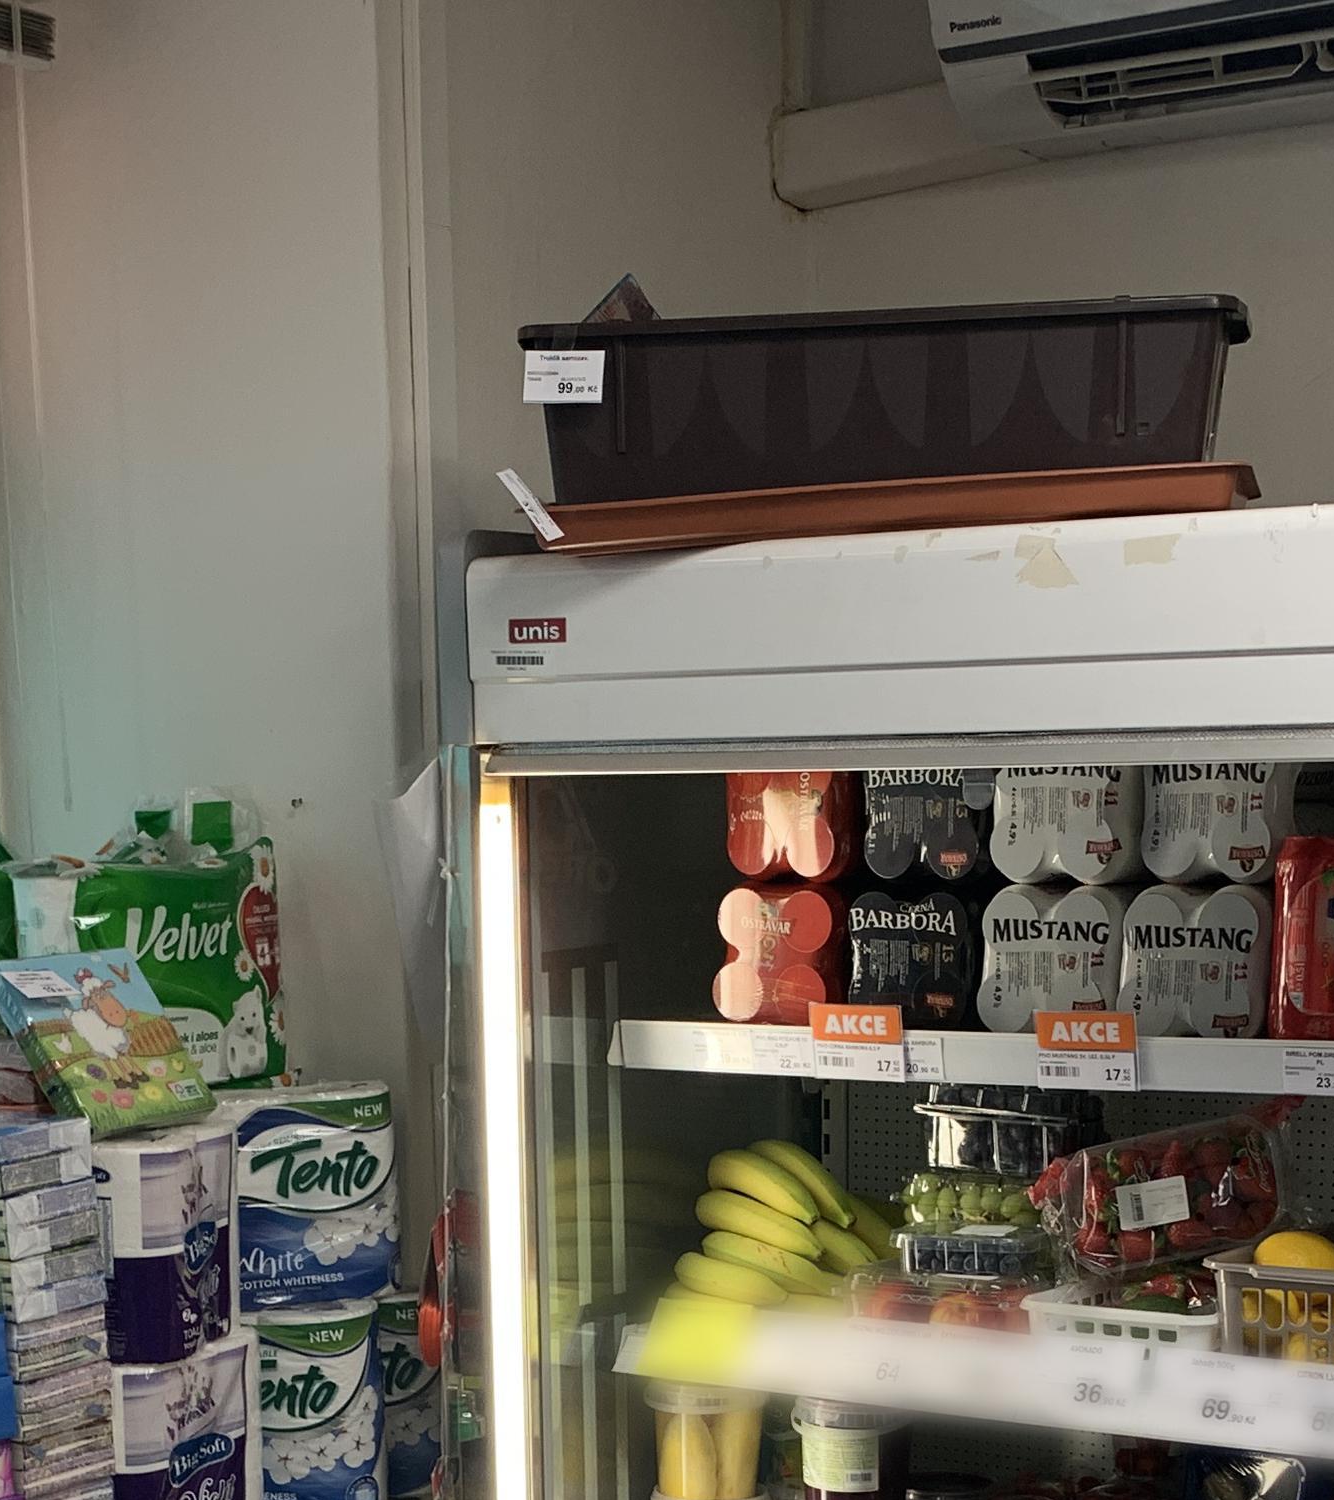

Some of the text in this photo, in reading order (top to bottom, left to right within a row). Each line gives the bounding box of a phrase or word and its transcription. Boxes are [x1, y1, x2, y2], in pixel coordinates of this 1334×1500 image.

[949, 15, 1003, 34] Panasonic
[514, 621, 561, 642] unis
[1152, 763, 1267, 787] MUSTANG
[850, 908, 956, 935] BARBORA
[992, 918, 1110, 944] MUSTANG
[126, 907, 233, 963] Velvet
[1134, 925, 1253, 953] MUSTANG
[825, 1015, 888, 1036] AKCE
[1051, 1021, 1121, 1043] AKCE
[1105, 1068, 1120, 1079] 17
[353, 1104, 384, 1119] NEW
[249, 1138, 376, 1198] Tento
[283, 1273, 344, 1287] WHITENESS
[309, 1329, 344, 1344] NEW
